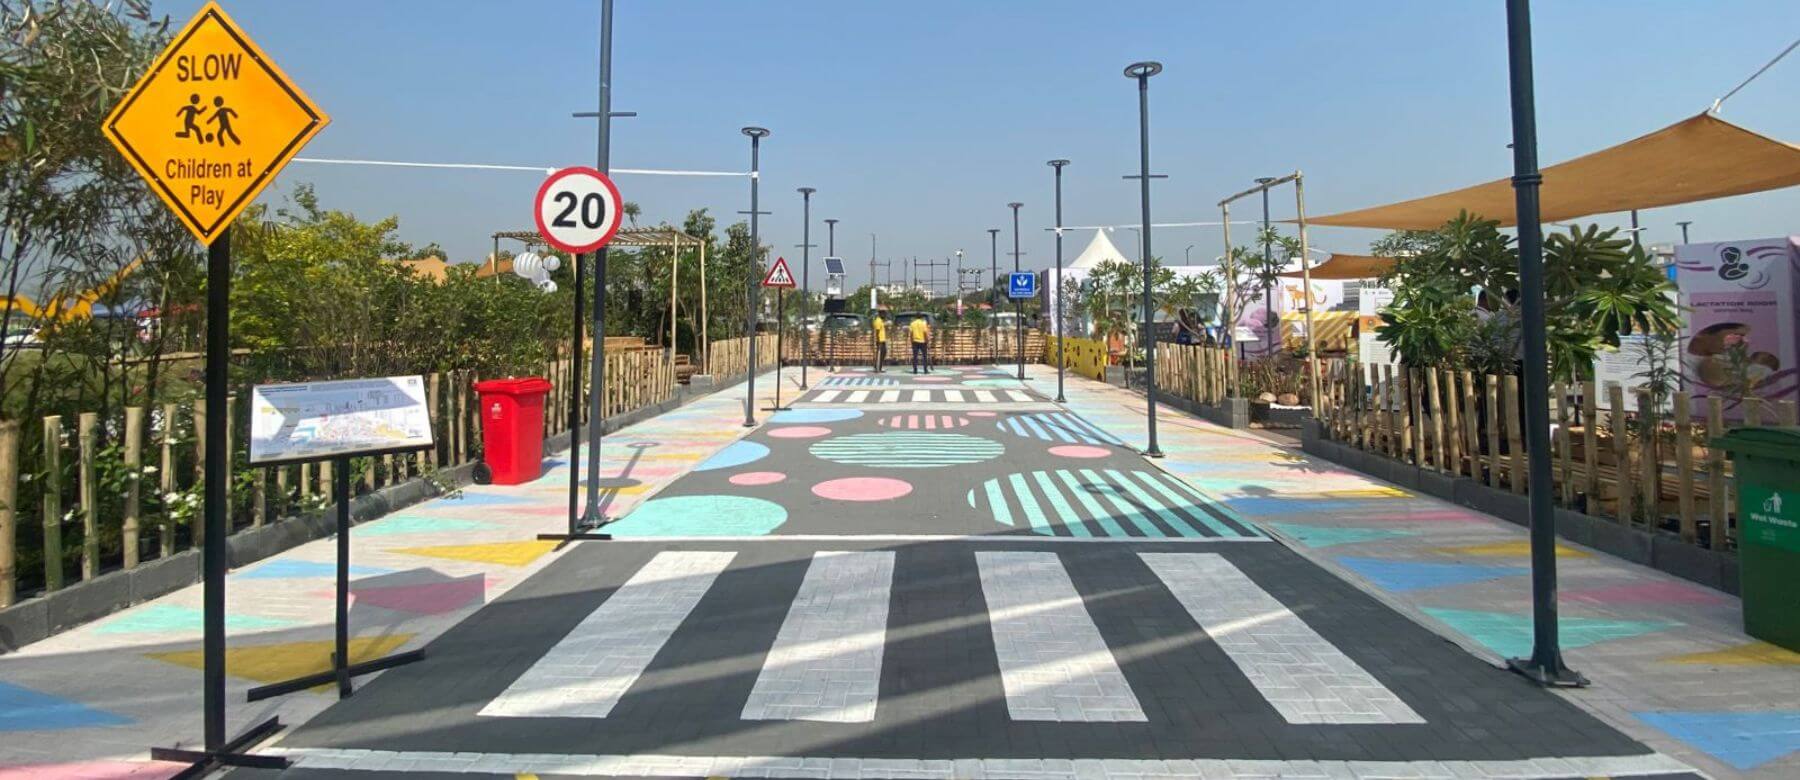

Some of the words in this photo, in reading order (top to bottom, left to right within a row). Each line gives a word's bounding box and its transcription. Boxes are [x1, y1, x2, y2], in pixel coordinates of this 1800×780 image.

[177, 53, 242, 82] SLOW
[165, 158, 232, 179] Children
[237, 158, 252, 178] at
[191, 185, 224, 210] Play
[552, 191, 605, 229] 20
[1750, 512, 1767, 522] Wet
[1768, 517, 1797, 528] Waste
